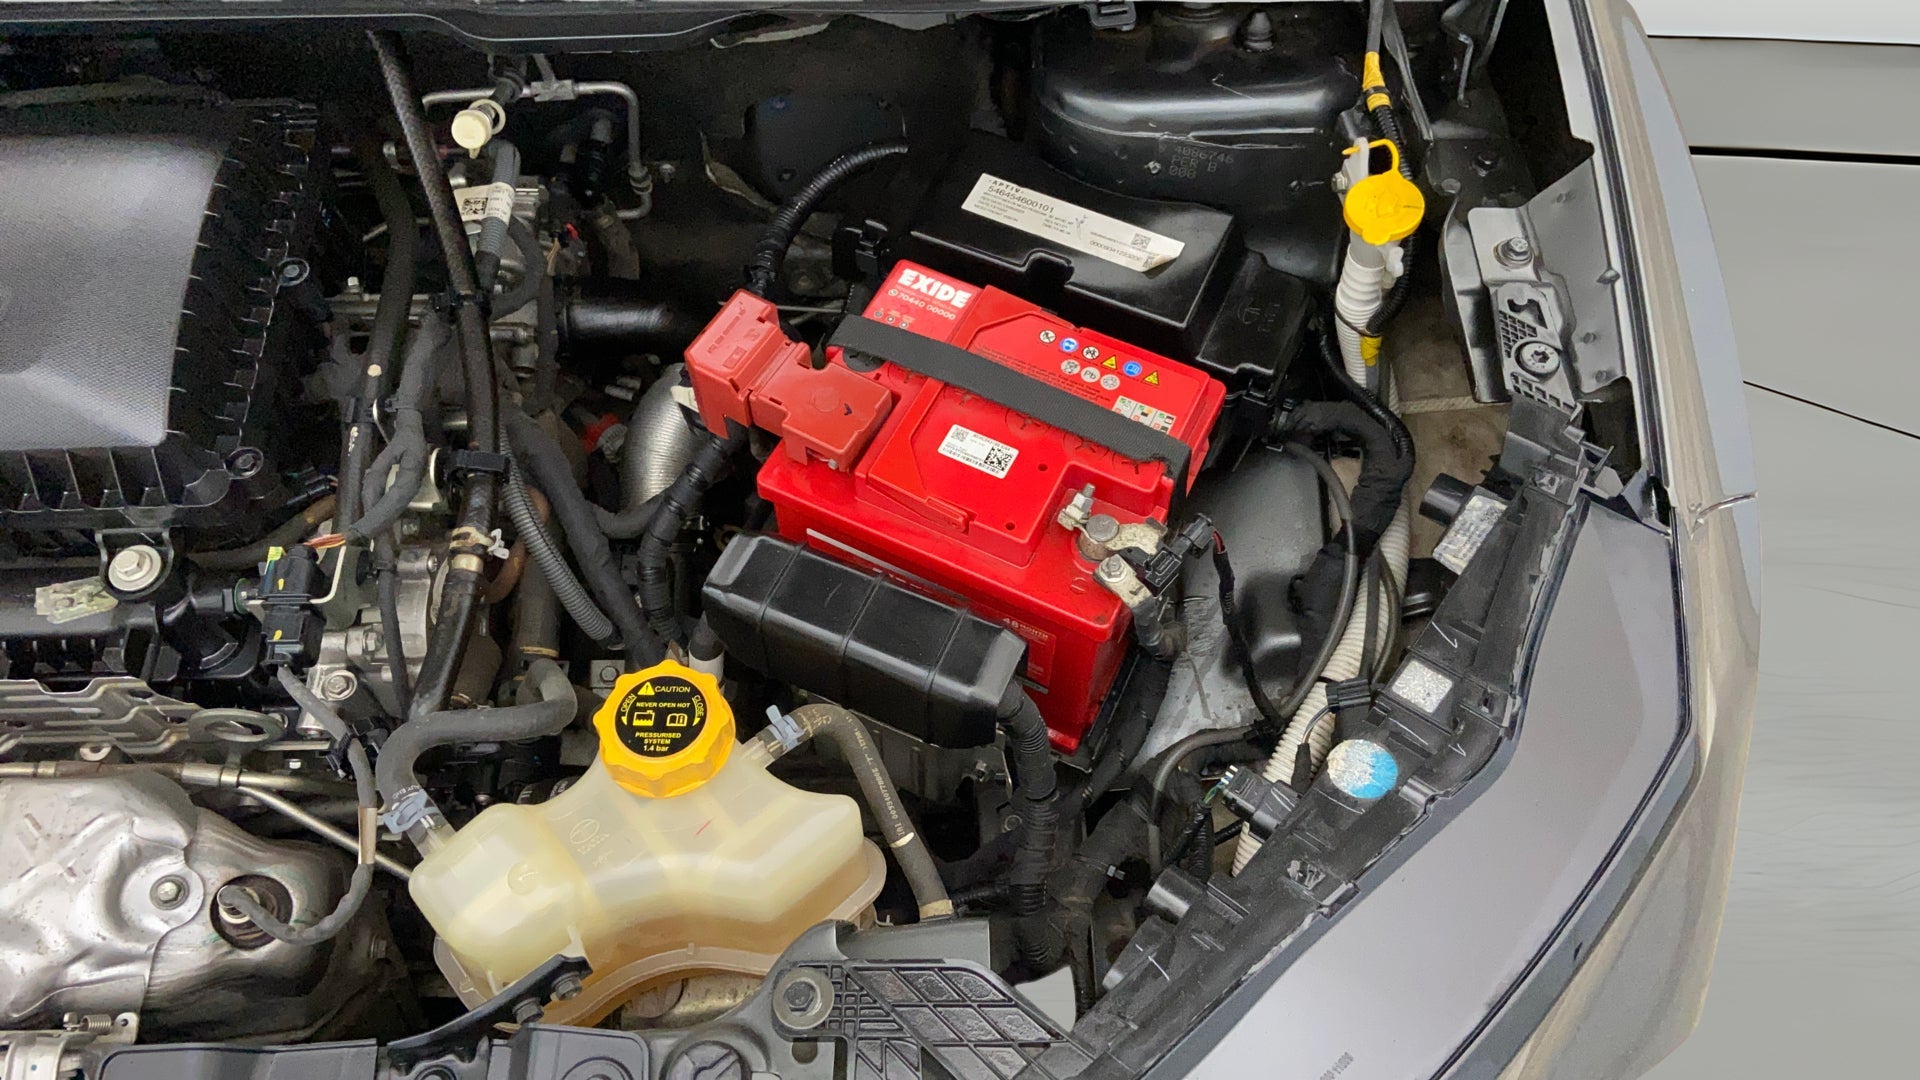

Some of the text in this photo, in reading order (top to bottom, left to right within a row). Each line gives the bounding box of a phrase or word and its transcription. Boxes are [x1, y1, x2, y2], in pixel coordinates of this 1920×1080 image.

[991, 180, 1021, 193] APTIV
[897, 268, 972, 309] EXIDE
[898, 291, 926, 308] 70440
[926, 303, 957, 321] 00000
[1083, 370, 1097, 380] Pb
[620, 692, 636, 712] OPEN
[693, 694, 705, 717] CLOSE
